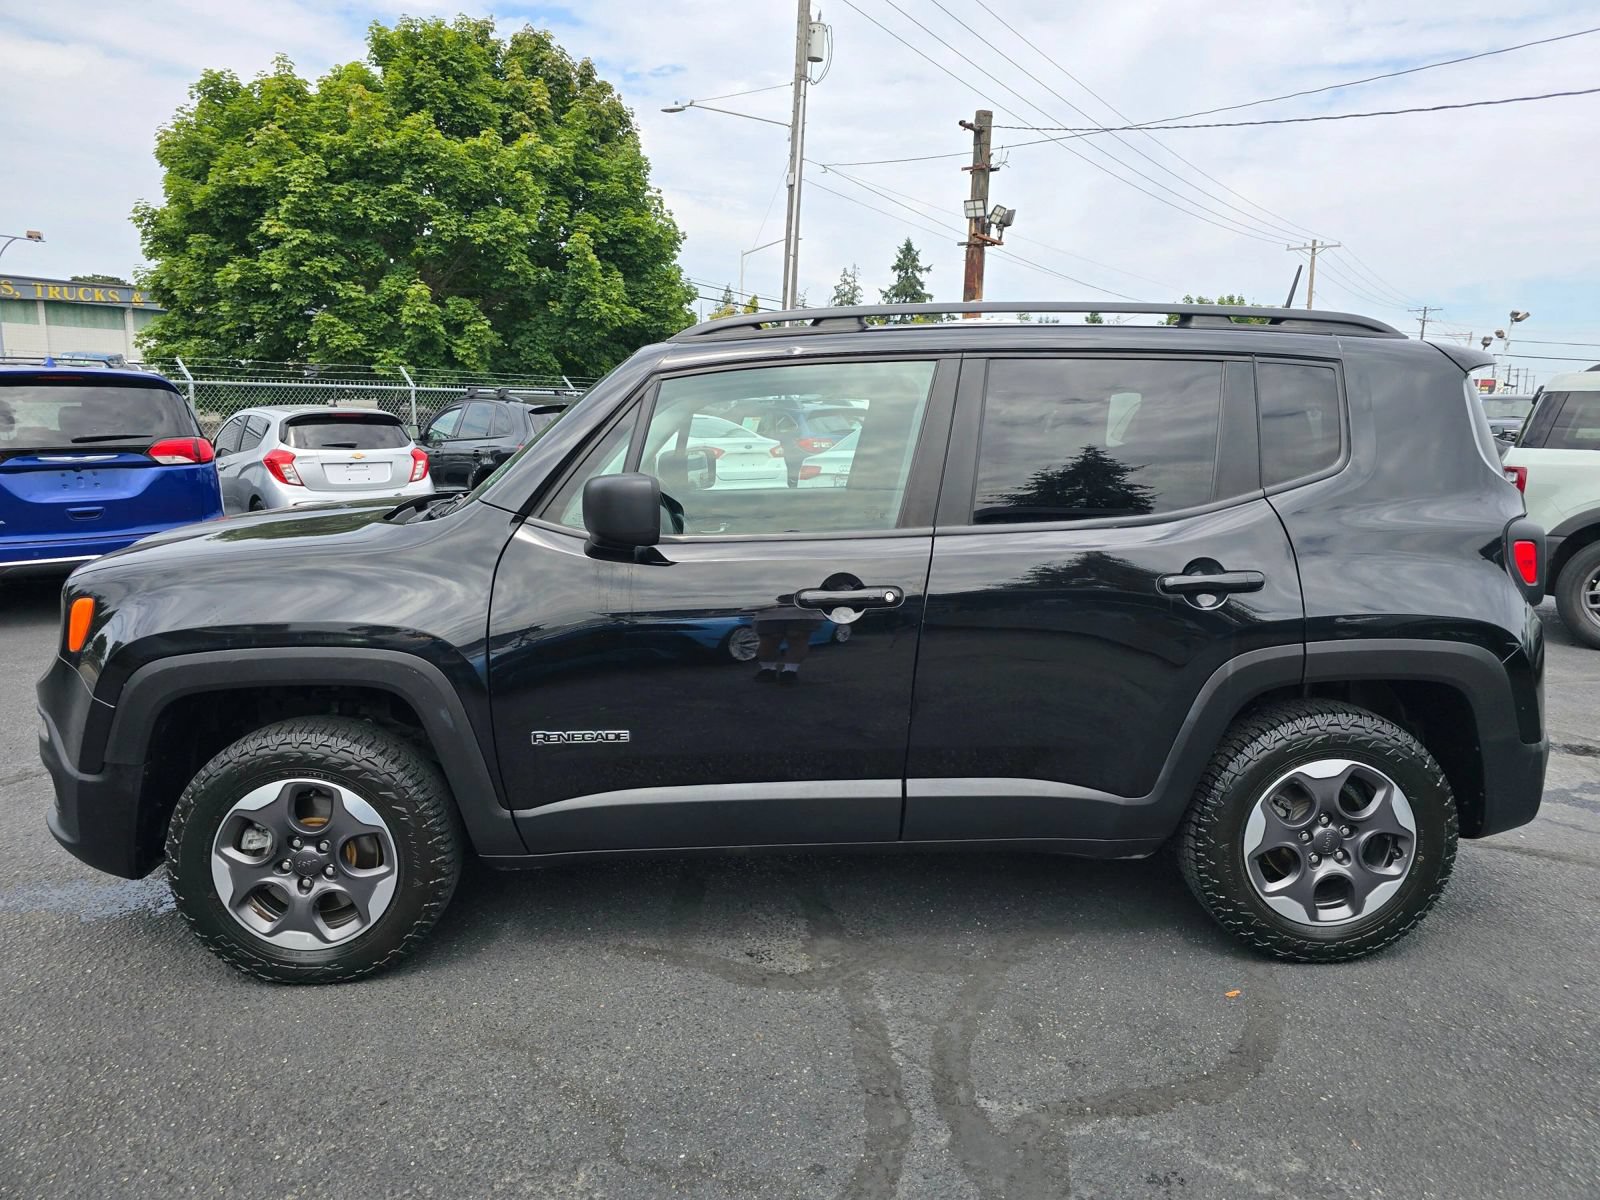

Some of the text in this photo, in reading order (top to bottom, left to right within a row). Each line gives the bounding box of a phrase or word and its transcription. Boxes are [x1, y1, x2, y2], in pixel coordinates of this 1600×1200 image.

[32, 282, 120, 304] TRUCKS
[132, 292, 144, 306] &
[531, 730, 630, 745] RENEGADE
